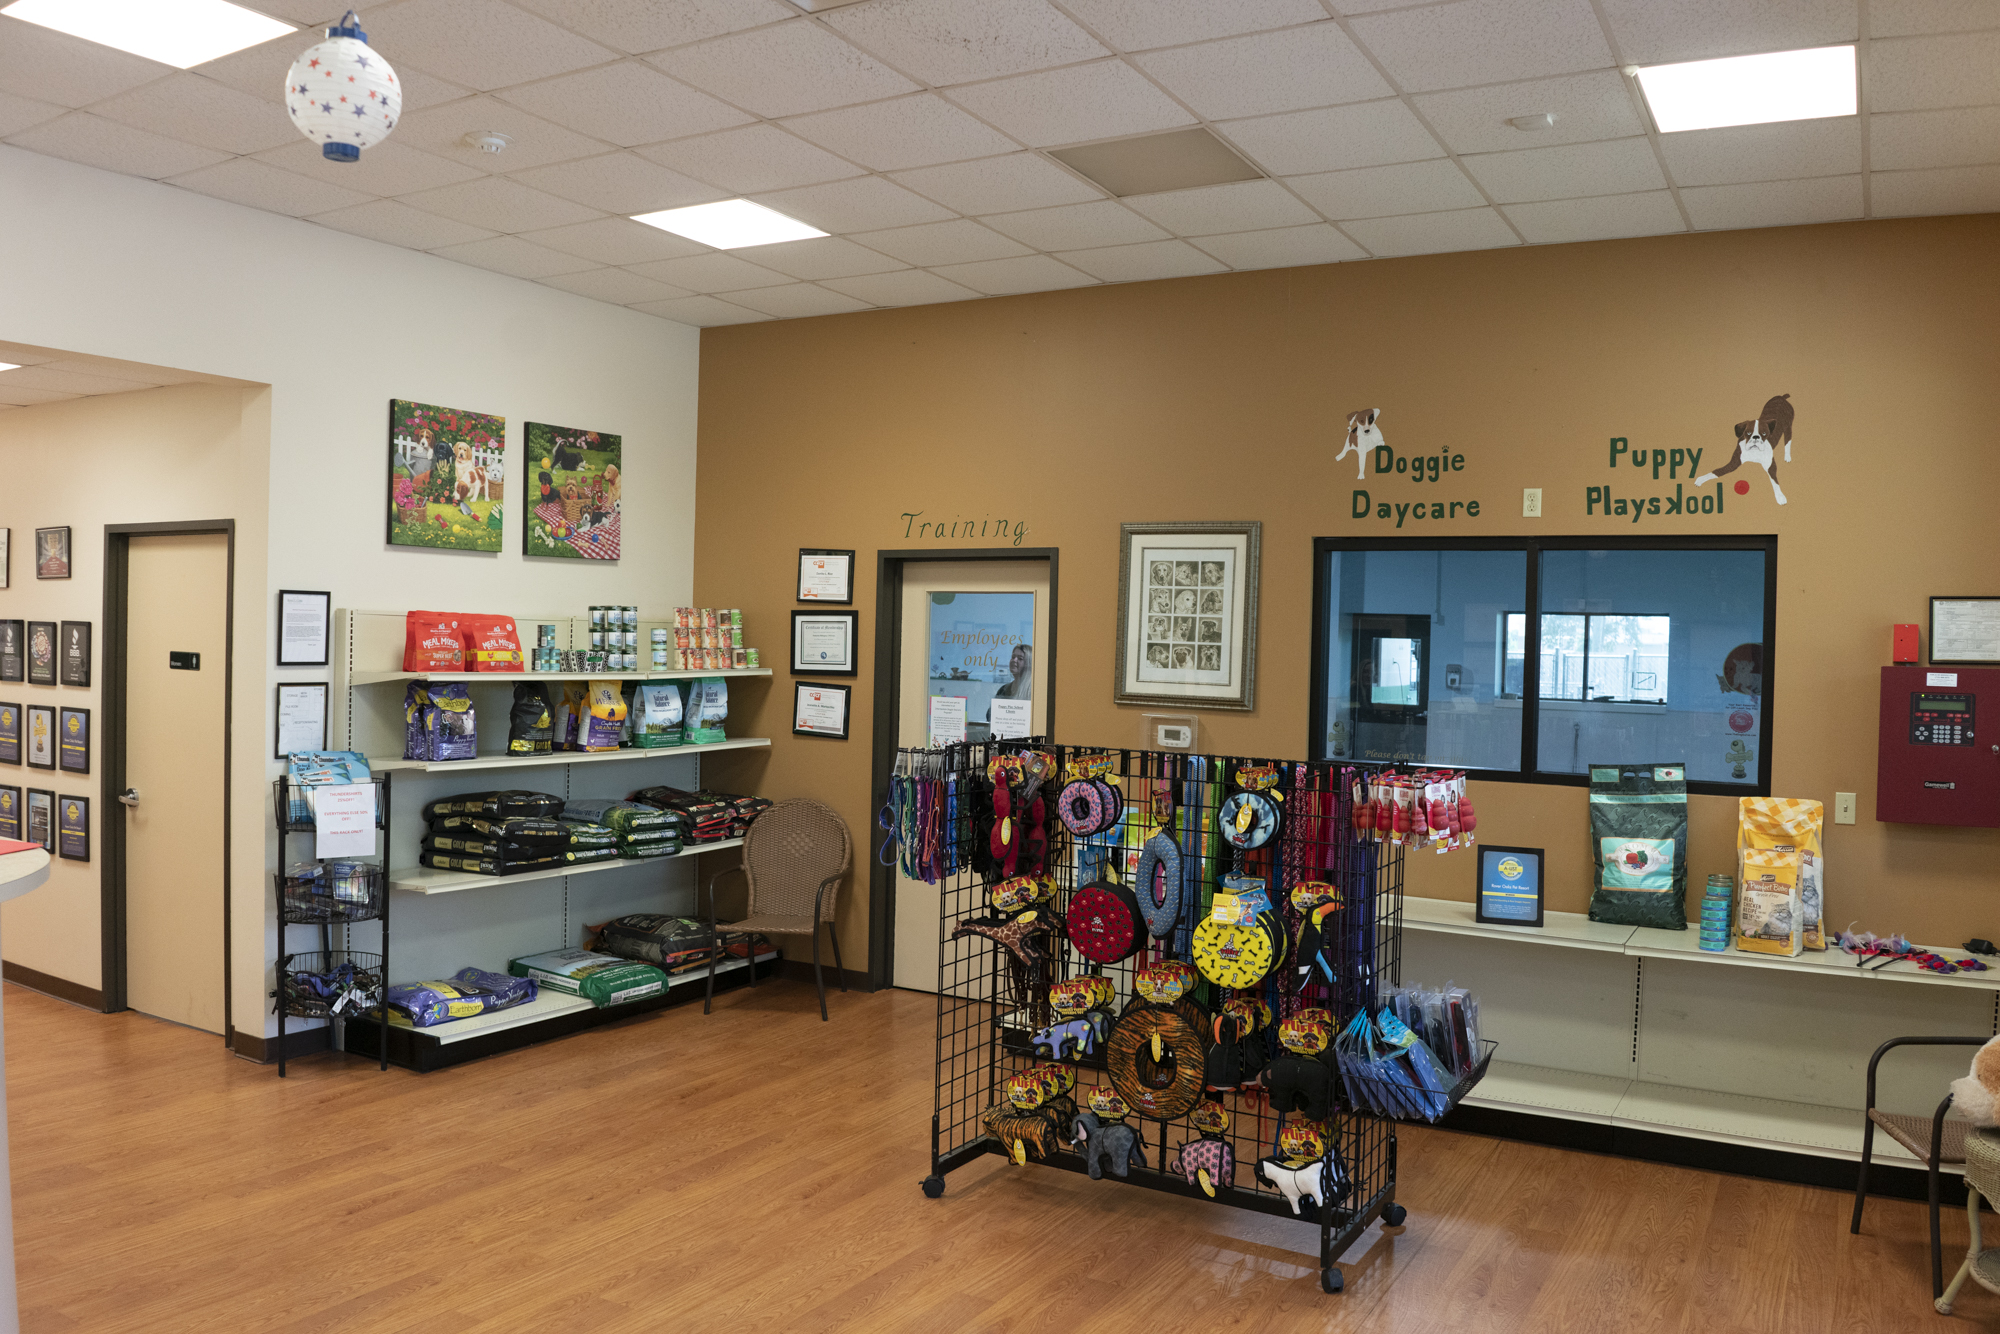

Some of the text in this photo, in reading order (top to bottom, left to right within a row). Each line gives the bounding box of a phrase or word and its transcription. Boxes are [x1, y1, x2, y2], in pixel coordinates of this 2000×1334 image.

[1375, 445, 1465, 482] Doggie
[1610, 437, 1703, 480] Puppy
[1352, 490, 1480, 528] Daycare
[1586, 482, 1723, 523] Playskool
[901, 511, 1029, 546] Training
[423, 637, 459, 649] MEAL MIXERS
[482, 640, 498, 650] MEAL
[941, 629, 1023, 650] Employees
[964, 651, 999, 672] only
[1365, 749, 1391, 759] Please
[1393, 751, 1414, 760] don't
[992, 875, 1031, 896] TUFFY
[1139, 970, 1180, 984] TUFFY
[1051, 984, 1090, 994] TUFFY
[450, 1004, 482, 1015] Earthborn
[490, 995, 509, 1009] Puppy
[1282, 1019, 1324, 1035] TUFFY
[1010, 1076, 1041, 1090] TUFFY
[1282, 1128, 1319, 1142] TUFFY
